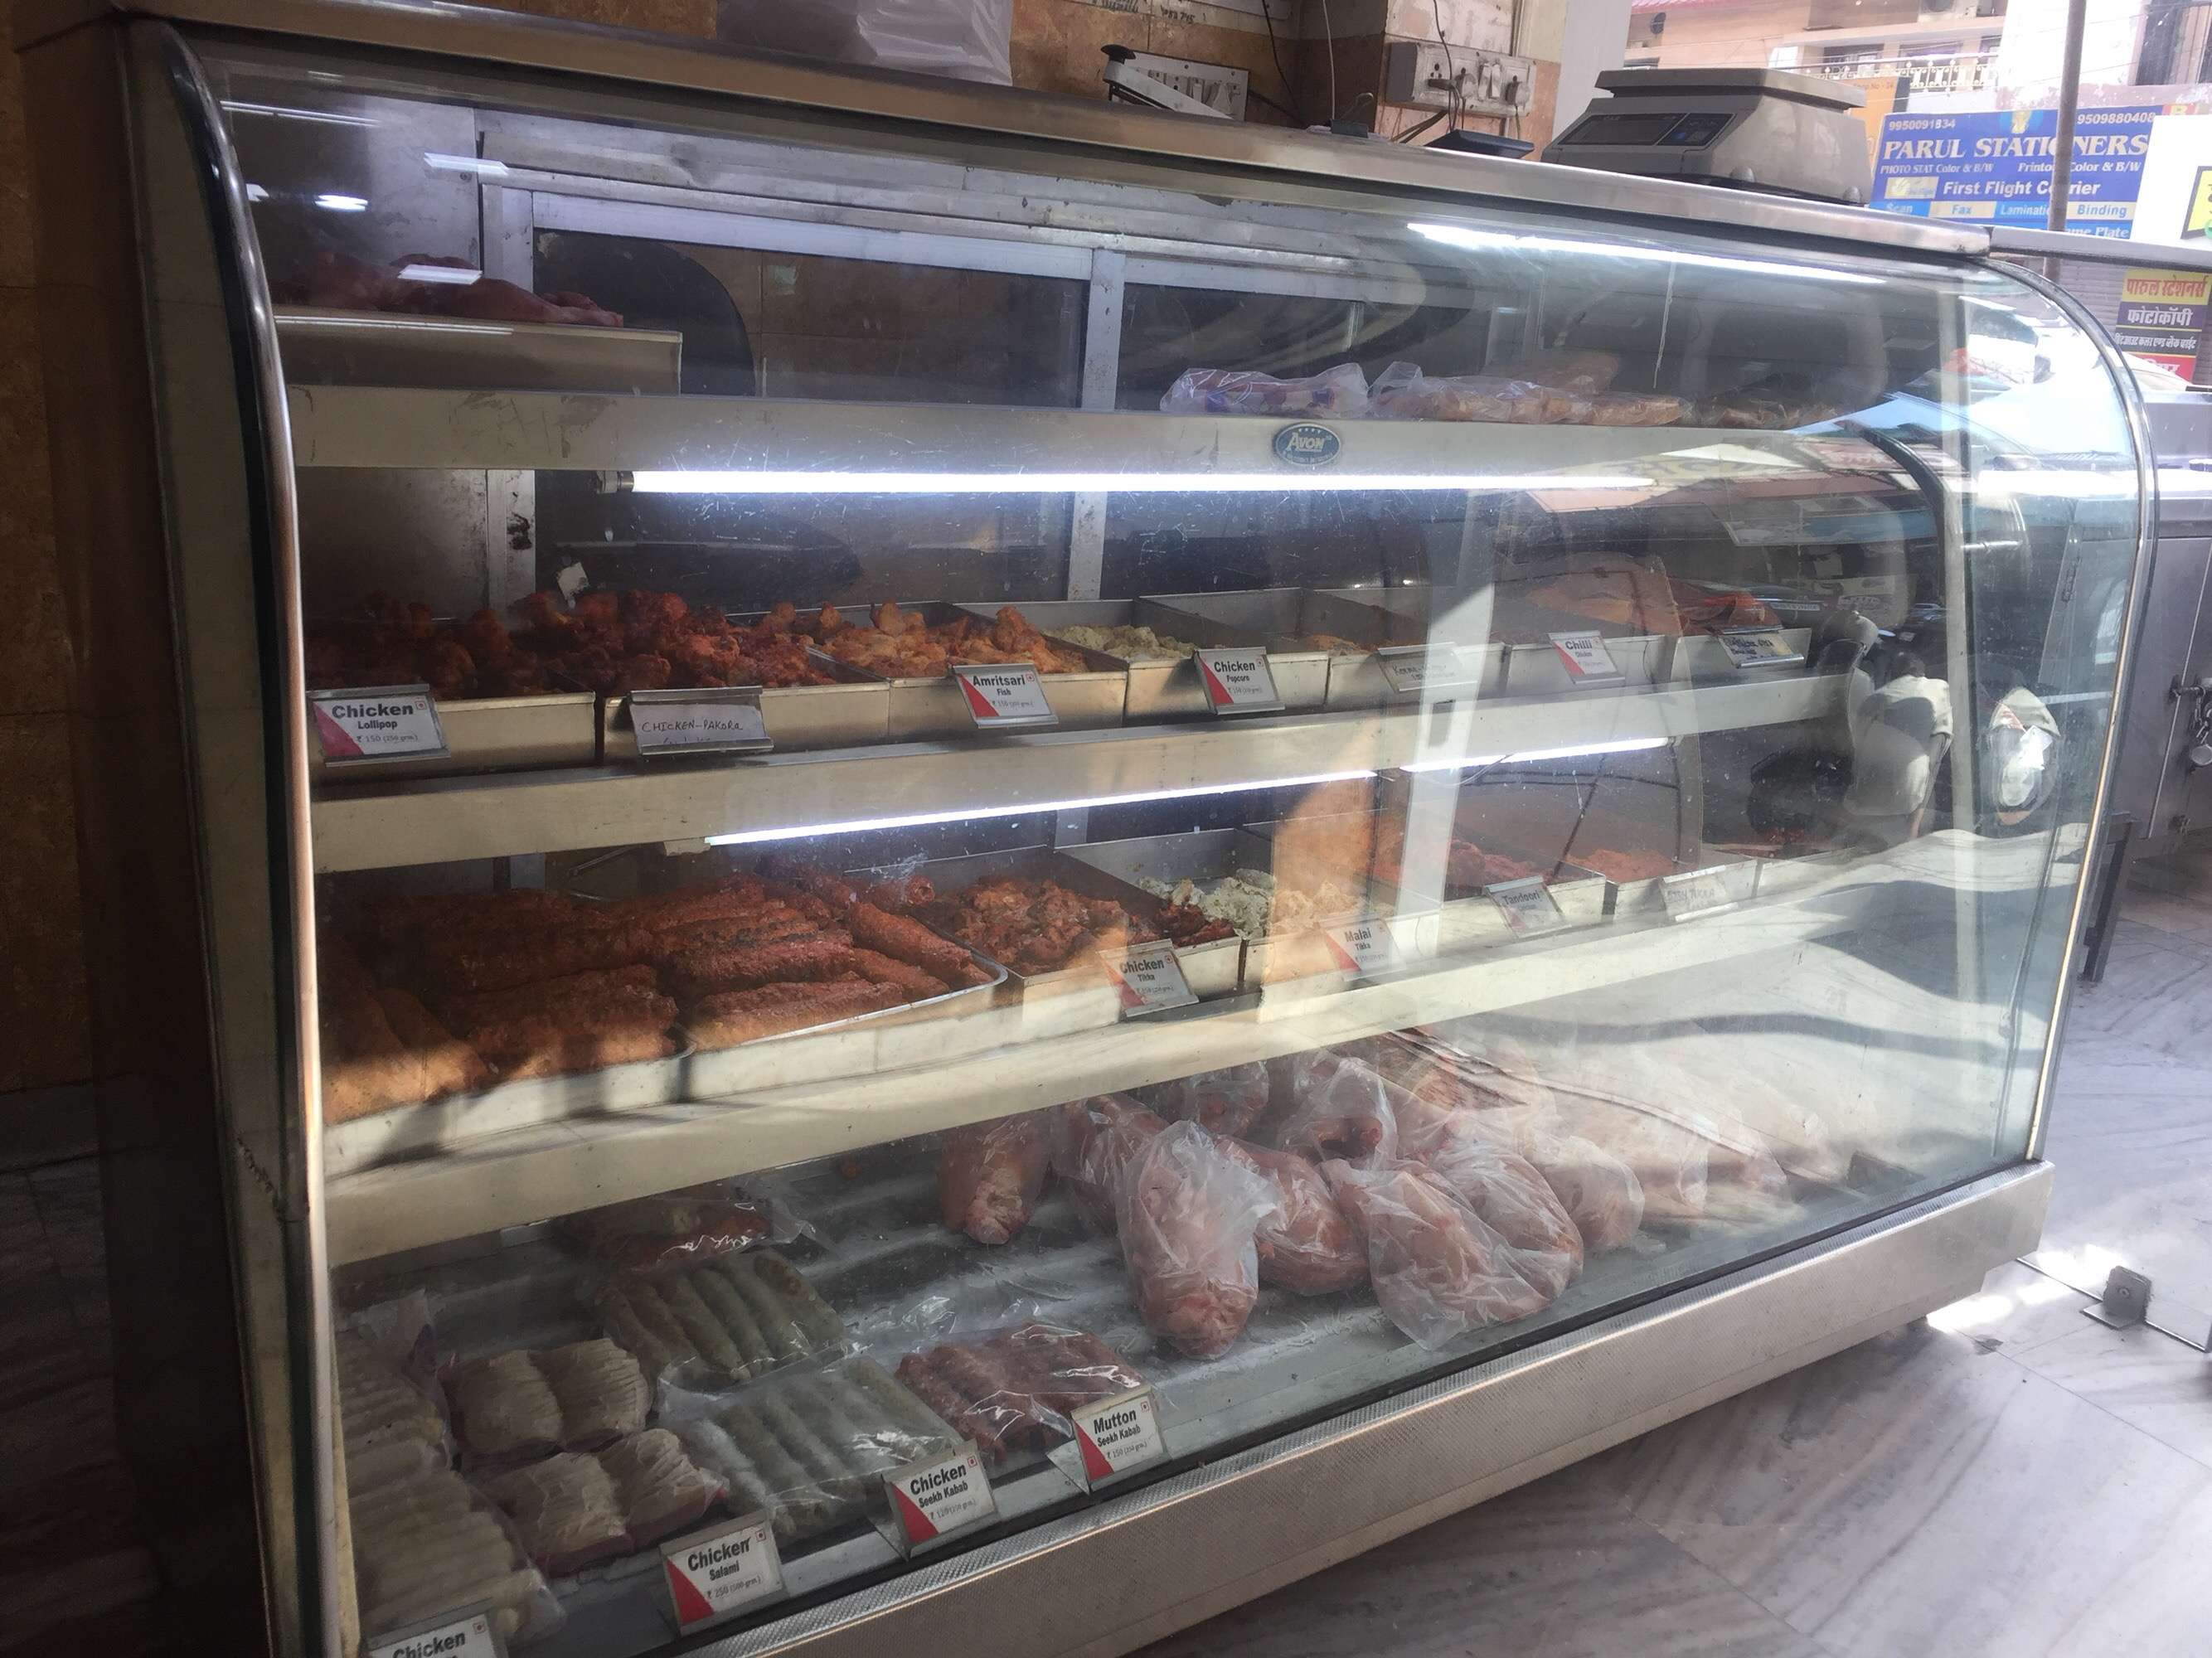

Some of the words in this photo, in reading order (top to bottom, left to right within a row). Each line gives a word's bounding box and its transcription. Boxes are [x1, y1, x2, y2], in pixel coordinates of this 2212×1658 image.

[1882, 139, 1966, 159] PARUL
[1880, 165, 1911, 174] PHOTO
[1913, 164, 1934, 173] STAT
[1936, 163, 1960, 173] Color
[2102, 162, 2112, 172] &
[2115, 161, 2142, 172] B/W
[1943, 182, 1981, 195] First
[1985, 180, 2033, 198] Flight
[2036, 180, 2101, 195] Crier
[1885, 202, 1914, 214] Scan
[1952, 204, 1972, 215] Fax
[2077, 204, 2127, 219] Binding
[2095, 225, 2129, 239] Plate
[2127, 305, 2194, 327] फोटोकॉपी
[1565, 639, 1593, 650] Chilli
[1214, 661, 1255, 673] Chicken
[973, 675, 1026, 686] Amritsari
[996, 688, 1011, 696] Fish
[332, 703, 414, 720] Chicken
[357, 720, 398, 730] Lollipop
[1501, 890, 1540, 905] Tandoori
[1344, 928, 1372, 943] Malai
[1120, 959, 1165, 974] Chicken
[1094, 1410, 1137, 1434] Mutton
[1097, 1433, 1118, 1447] Seekh
[1120, 1424, 1141, 1440] Kabab
[910, 1464, 967, 1495] Chicken
[918, 1492, 943, 1509] Seekh
[943, 1481, 968, 1499] Kabab
[687, 1537, 750, 1571] Chicken
[709, 1561, 740, 1581] Salami
